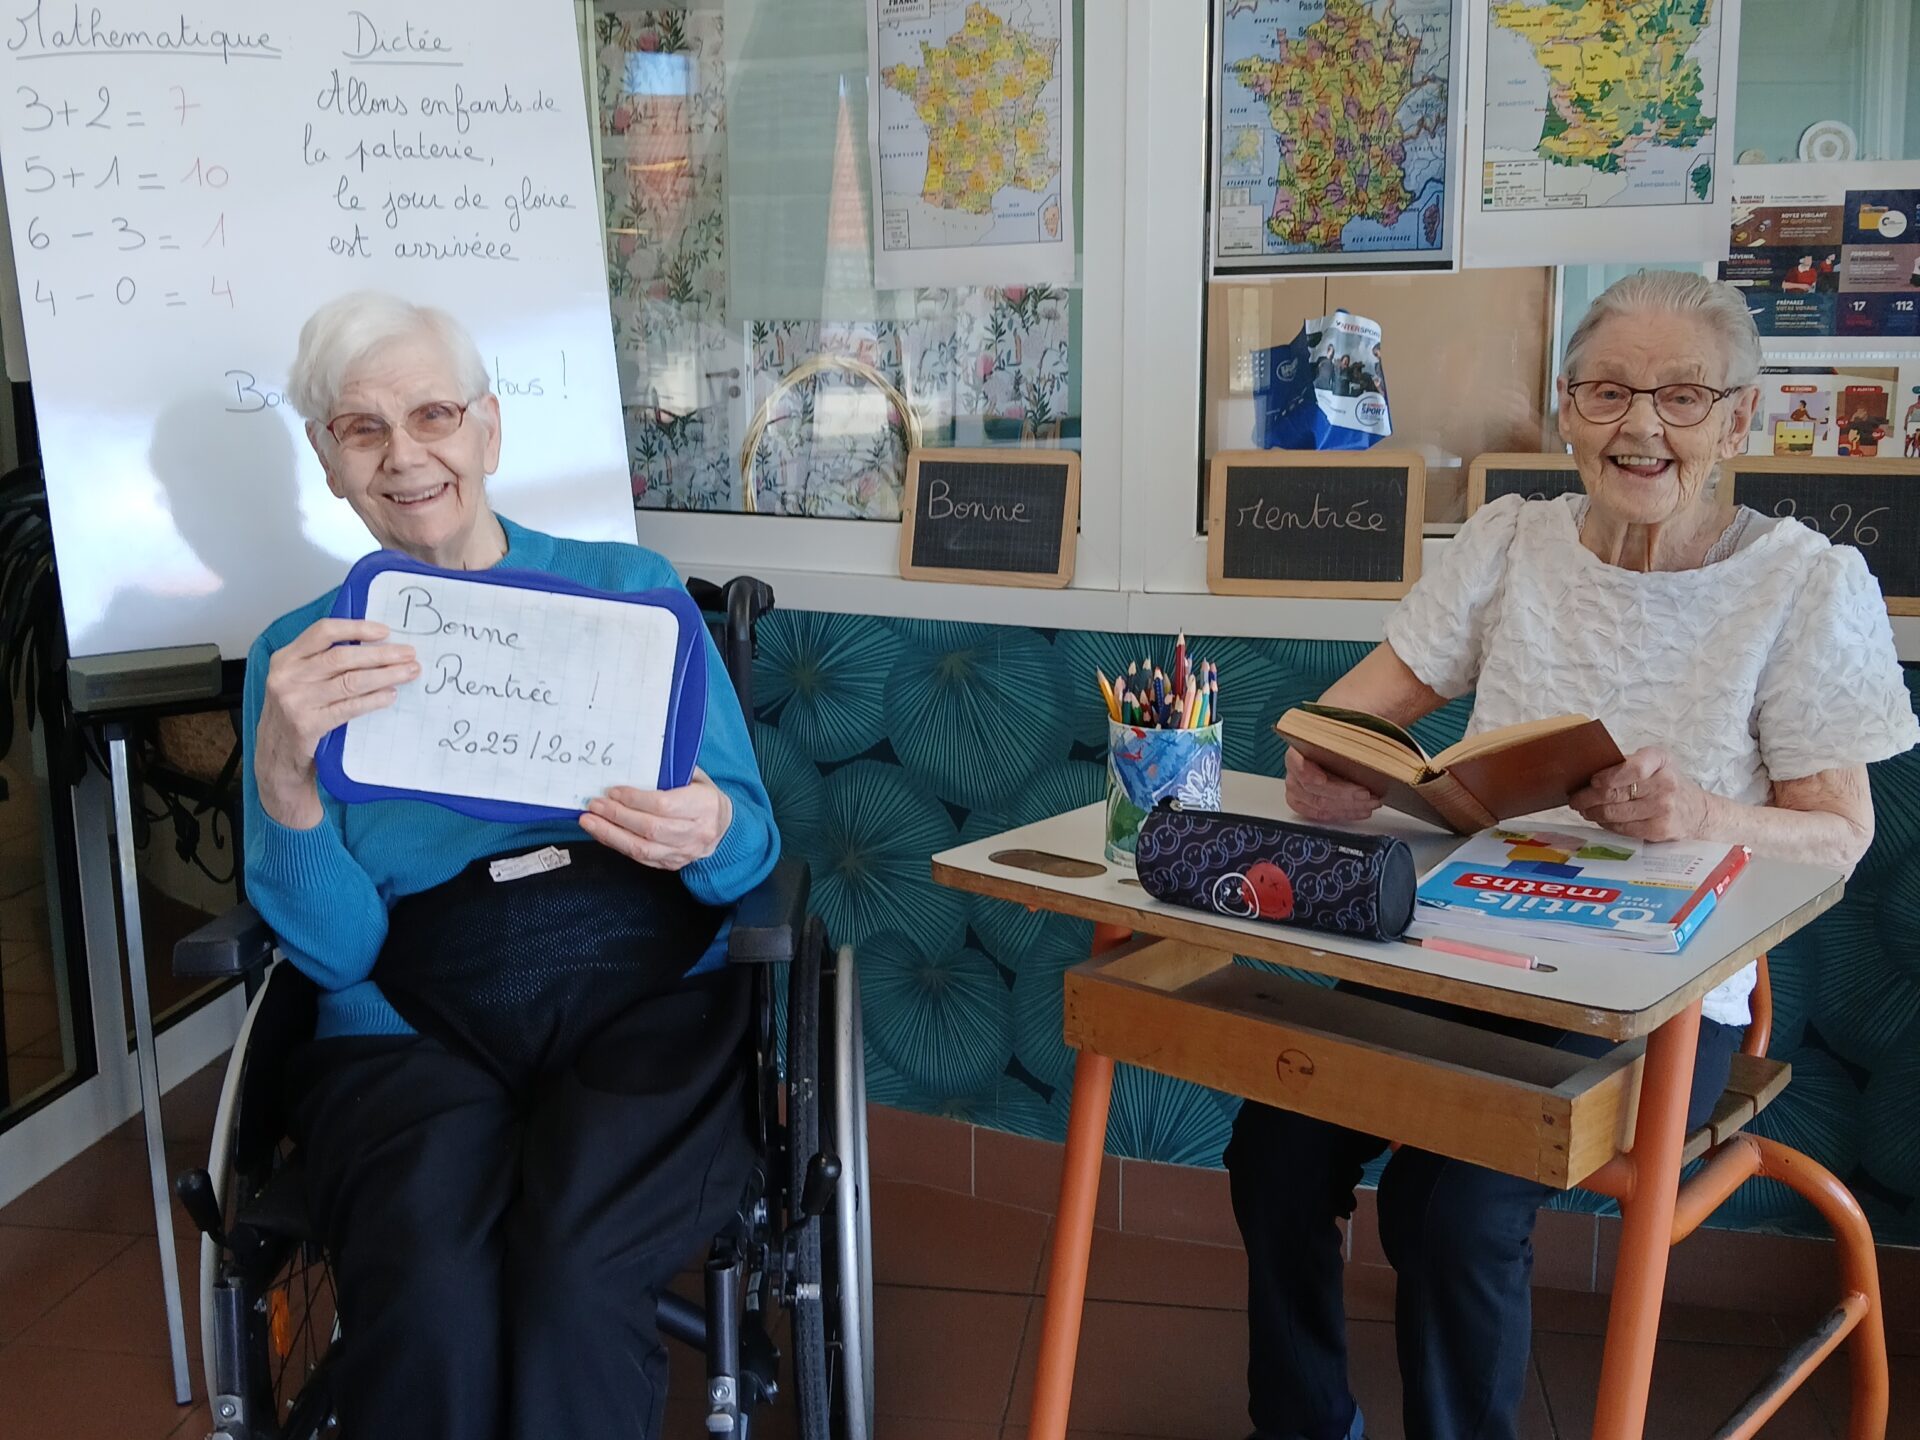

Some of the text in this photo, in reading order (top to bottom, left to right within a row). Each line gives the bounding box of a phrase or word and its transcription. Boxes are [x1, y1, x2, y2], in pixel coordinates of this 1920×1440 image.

[342, 10, 452, 58] Dictée
[168, 85, 201, 126] 7
[317, 68, 561, 134] Allons enfants de
[303, 122, 330, 165] la
[180, 157, 229, 188] 10
[332, 175, 577, 232] le jour de gloire
[28, 216, 50, 250] 6
[111, 217, 146, 251] 3
[201, 212, 225, 249] 1
[328, 223, 371, 258] est
[35, 279, 56, 317] 4
[115, 276, 136, 305] 0
[211, 275, 234, 309] 4
[1852, 301, 1866, 311] 17
[1895, 301, 1914, 311] 112
[928, 479, 1032, 523] Bonne
[390, 586, 525, 651] Bonne
[424, 653, 559, 706] Rentrée
[1469, 874, 1609, 899] maths
[1618, 899, 1662, 909] pour
[1623, 894, 1651, 904] les
[1475, 890, 1655, 924] Outils
